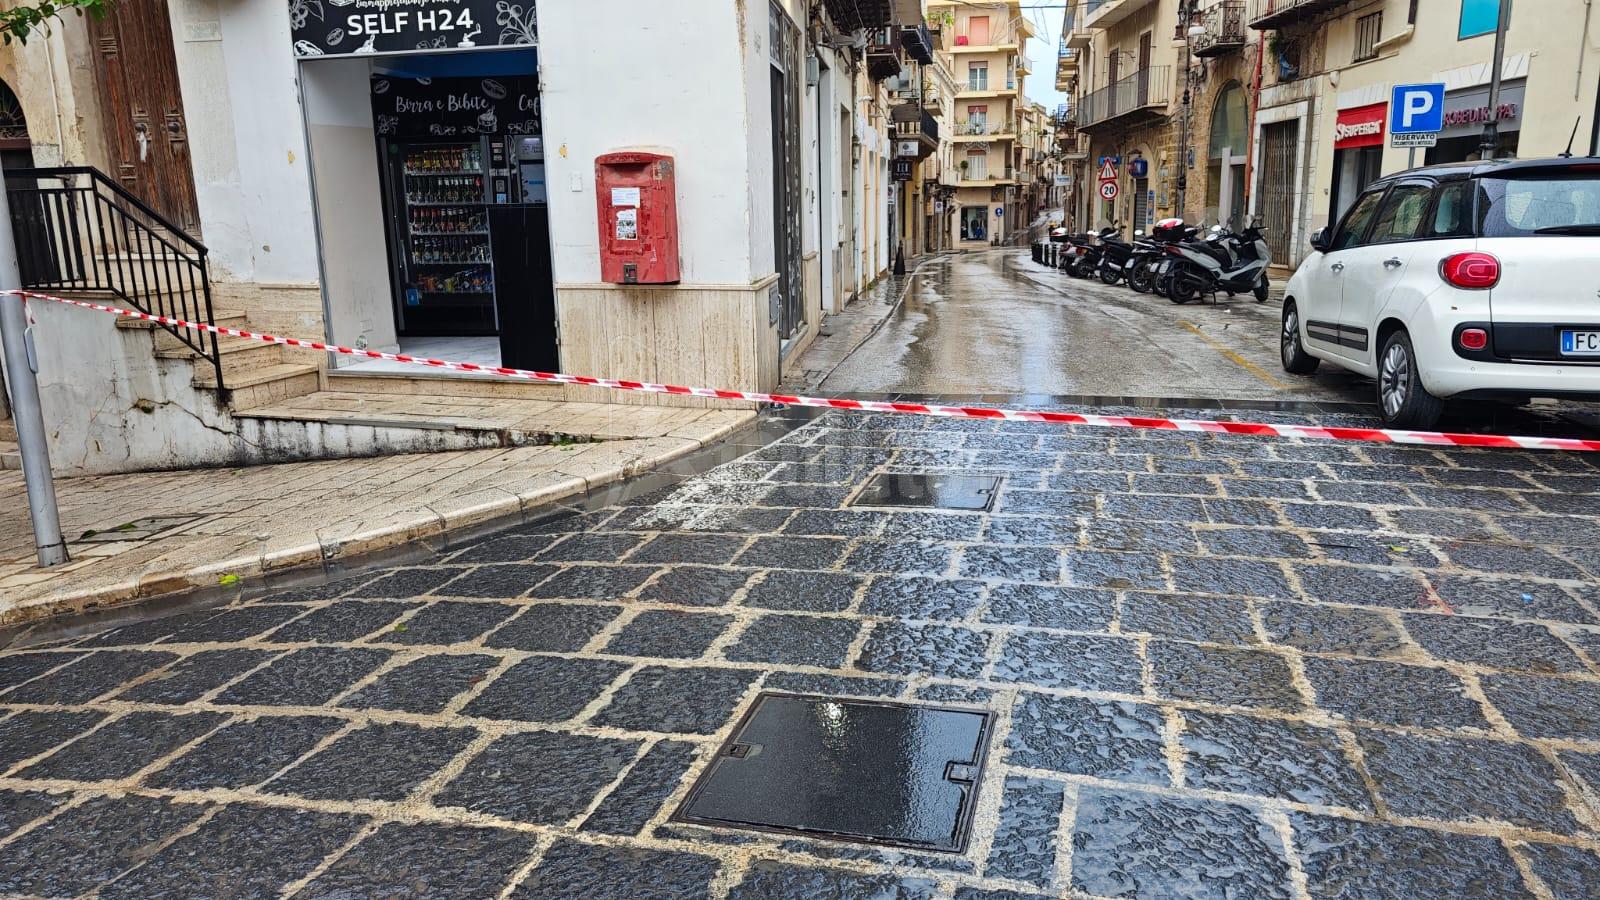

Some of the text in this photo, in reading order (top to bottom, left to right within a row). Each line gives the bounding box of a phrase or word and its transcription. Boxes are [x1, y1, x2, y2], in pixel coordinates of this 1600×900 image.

[347, 8, 474, 35] SELF H24
[396, 93, 489, 113] Birra e Bibite
[1402, 91, 1434, 127] P
[1481, 103, 1515, 121] KPPA
[1344, 121, 1381, 138] SUPERGA
[1104, 186, 1115, 195] 20
